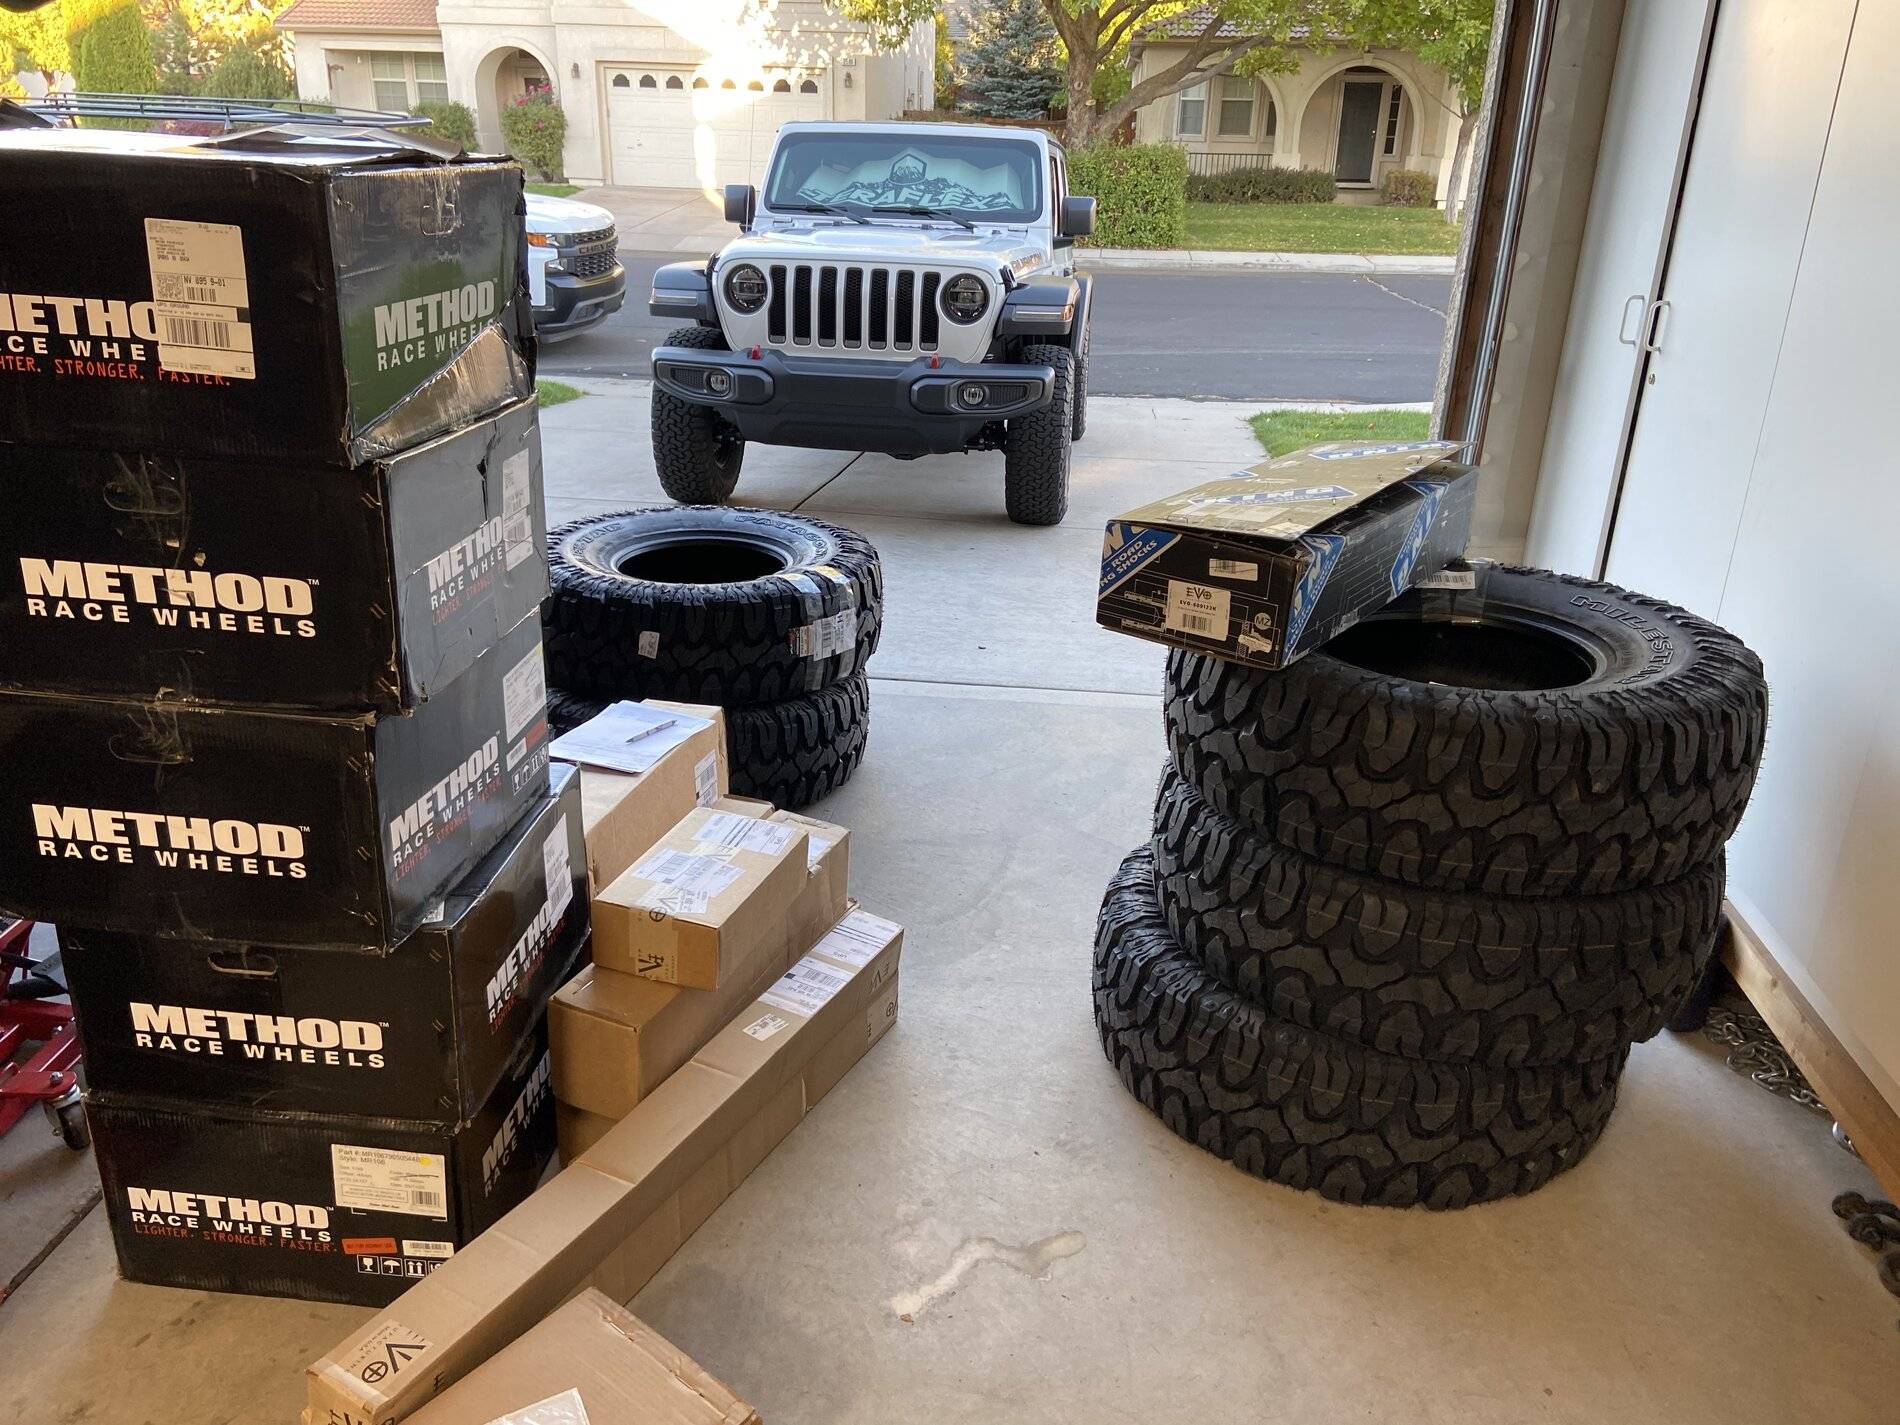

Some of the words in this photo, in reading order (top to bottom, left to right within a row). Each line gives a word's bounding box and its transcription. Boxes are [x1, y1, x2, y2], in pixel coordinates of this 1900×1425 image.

[0, 293, 158, 341] ETHO
[374, 280, 495, 349] METHOD
[0, 335, 48, 354] CE
[69, 339, 147, 361] WHE
[54, 358, 144, 380] STRONGER.
[377, 340, 426, 371] RACE
[428, 515, 503, 593] METHO
[1111, 540, 1143, 568] ROAD
[1116, 540, 1158, 574] SHOCKS
[20, 557, 314, 615] METHOD
[431, 575, 465, 611] RACE
[470, 547, 503, 582] WHEE
[1186, 586, 1212, 600] EVO
[27, 598, 131, 623] RACE
[155, 608, 316, 638] WHEELS
[390, 735, 499, 851] METHOD
[393, 824, 434, 868] RACE
[442, 763, 500, 822] WHEELS
[32, 803, 305, 858] METHOD
[39, 840, 133, 863] RACE
[156, 850, 307, 878] WHEELS
[487, 900, 550, 1010] METHO
[489, 978, 519, 1023] RACE
[523, 924, 552, 973] WHEE
[129, 1002, 384, 1051] METHOD
[136, 1033, 224, 1056] RACE
[243, 1042, 385, 1069] WHEELS
[482, 1049, 550, 1184] METHO
[485, 1140, 518, 1197] RACE
[127, 1185, 329, 1229] METHOD
[132, 1211, 199, 1229] RACE
[213, 1218, 332, 1243] WHEELS
[135, 1222, 194, 1240] LIGHTER.
[203, 1229, 273, 1248] STRONGER.
[280, 1237, 338, 1253] FASTER.
